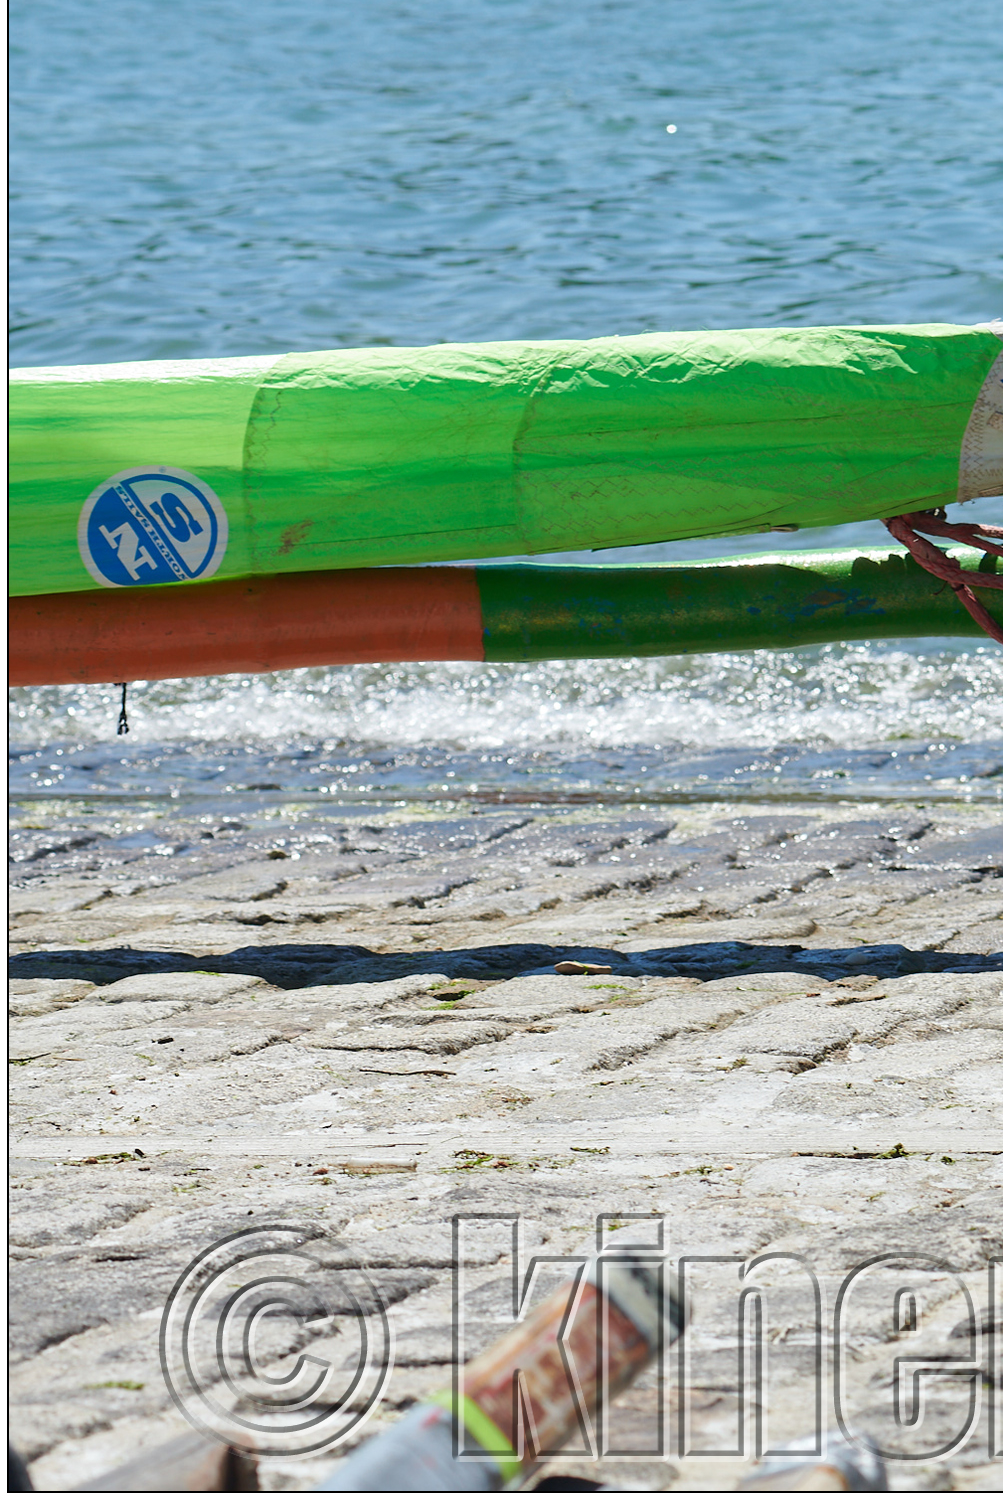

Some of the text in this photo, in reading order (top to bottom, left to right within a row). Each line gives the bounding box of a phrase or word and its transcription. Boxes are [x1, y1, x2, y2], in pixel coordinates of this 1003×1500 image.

[114, 485, 188, 580] NORTH SAILS
[149, 492, 204, 543] S
[98, 521, 158, 581] N
